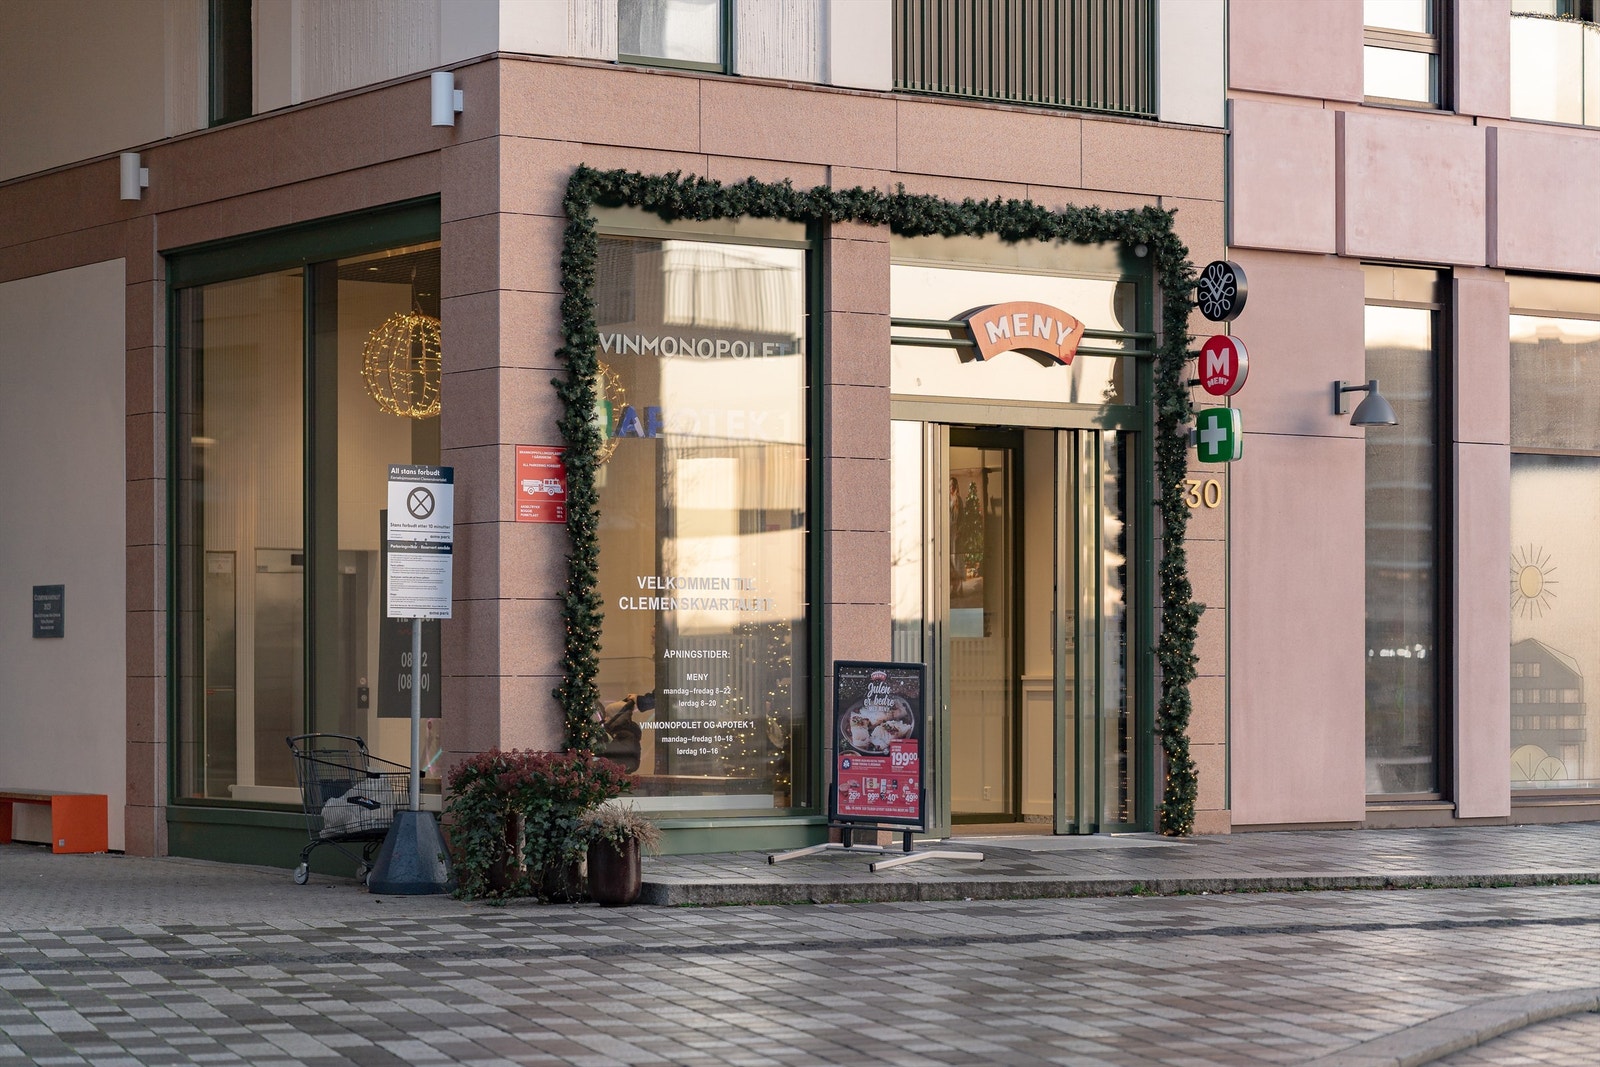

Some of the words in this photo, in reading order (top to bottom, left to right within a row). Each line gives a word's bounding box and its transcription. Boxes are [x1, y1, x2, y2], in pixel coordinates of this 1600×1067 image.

[985, 313, 1073, 345] MENY
[599, 332, 790, 362] VINMONOPOLET
[1206, 348, 1230, 378] M
[1207, 376, 1229, 387] MENY
[1186, 479, 1221, 508] 30
[637, 576, 730, 591] VELKOMMEN
[619, 597, 772, 612] CLEMENSKVARTALET
[664, 649, 731, 659] ÅPNINGSTIDER:
[867, 681, 891, 698] Julen
[678, 699, 699, 708] lørdag
[864, 697, 871, 706] er
[873, 695, 895, 707] bedre
[639, 721, 702, 729] VINMONOPOLET
[703, 721, 715, 729] OG
[716, 721, 748, 729] APOTEK
[676, 747, 698, 755] lørdag
